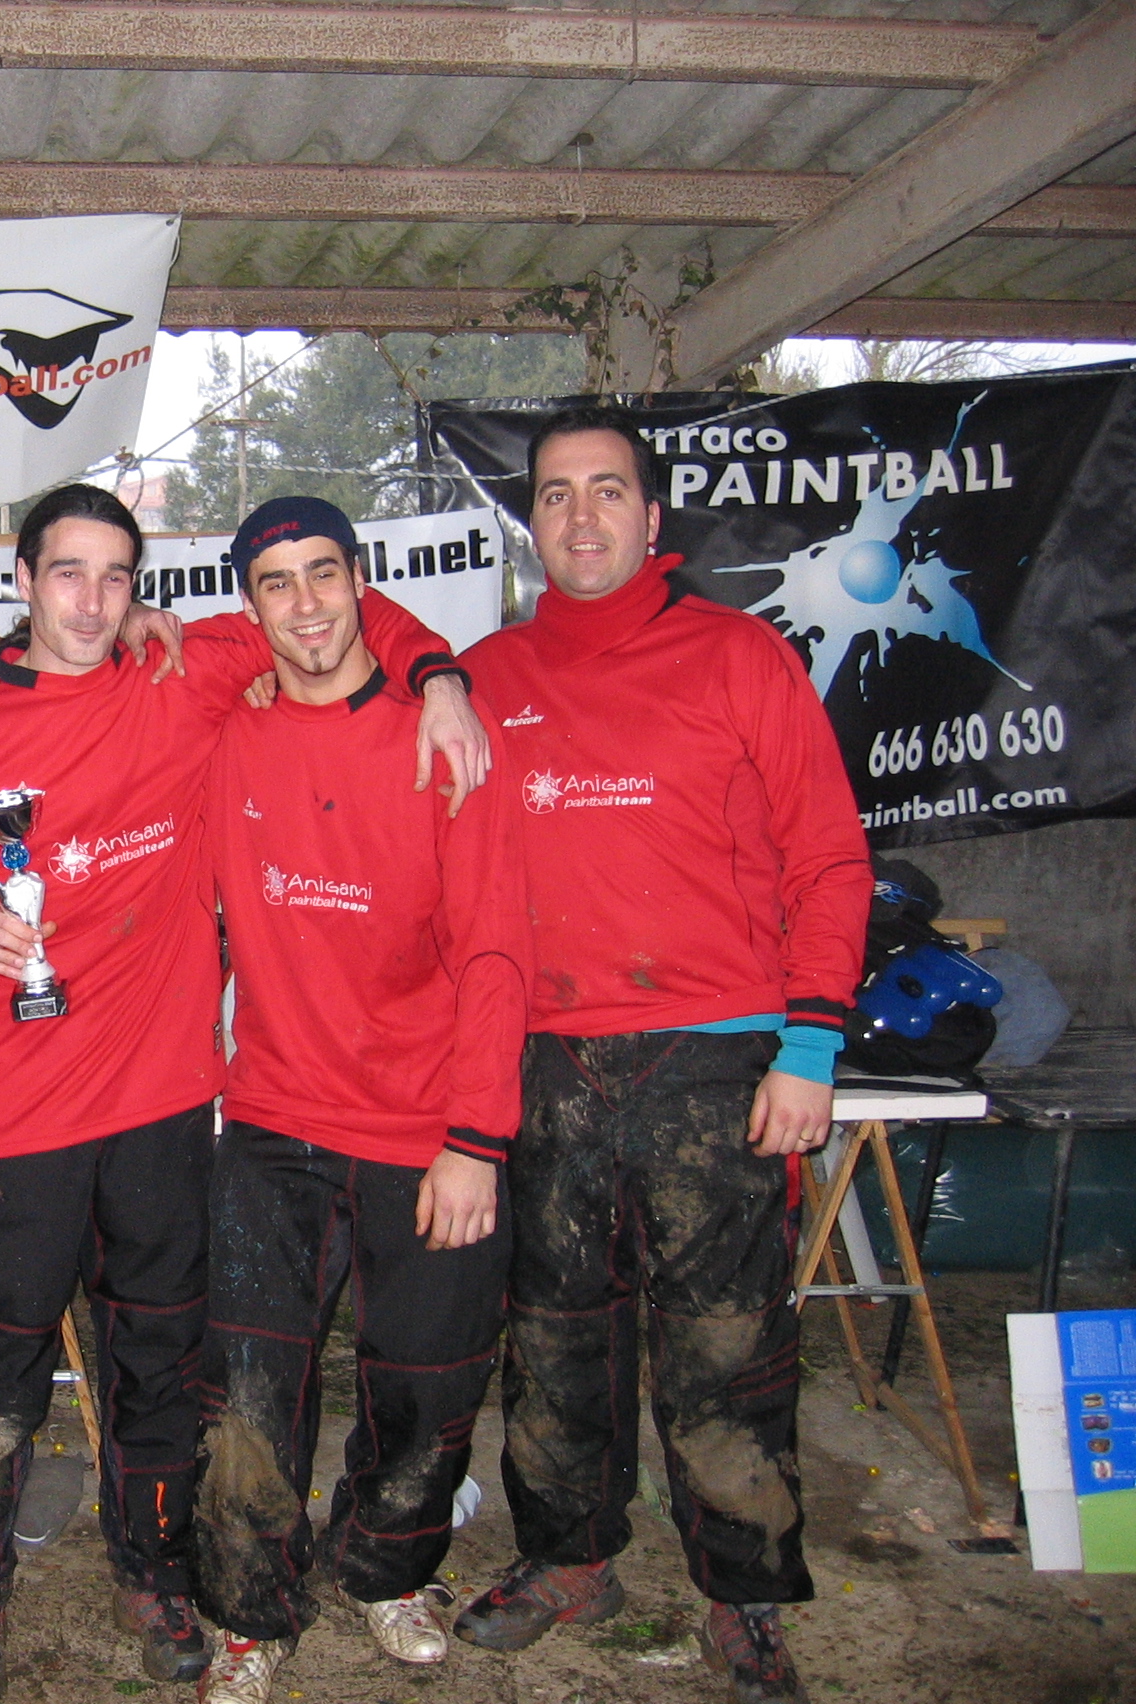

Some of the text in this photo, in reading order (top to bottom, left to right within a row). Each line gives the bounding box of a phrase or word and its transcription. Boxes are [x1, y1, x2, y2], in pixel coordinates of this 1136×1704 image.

[638, 425, 788, 455] rraco
[670, 443, 1014, 509] PAINTBALL
[868, 704, 1065, 778] 666 630 630
[858, 786, 1067, 829] aintball.com
